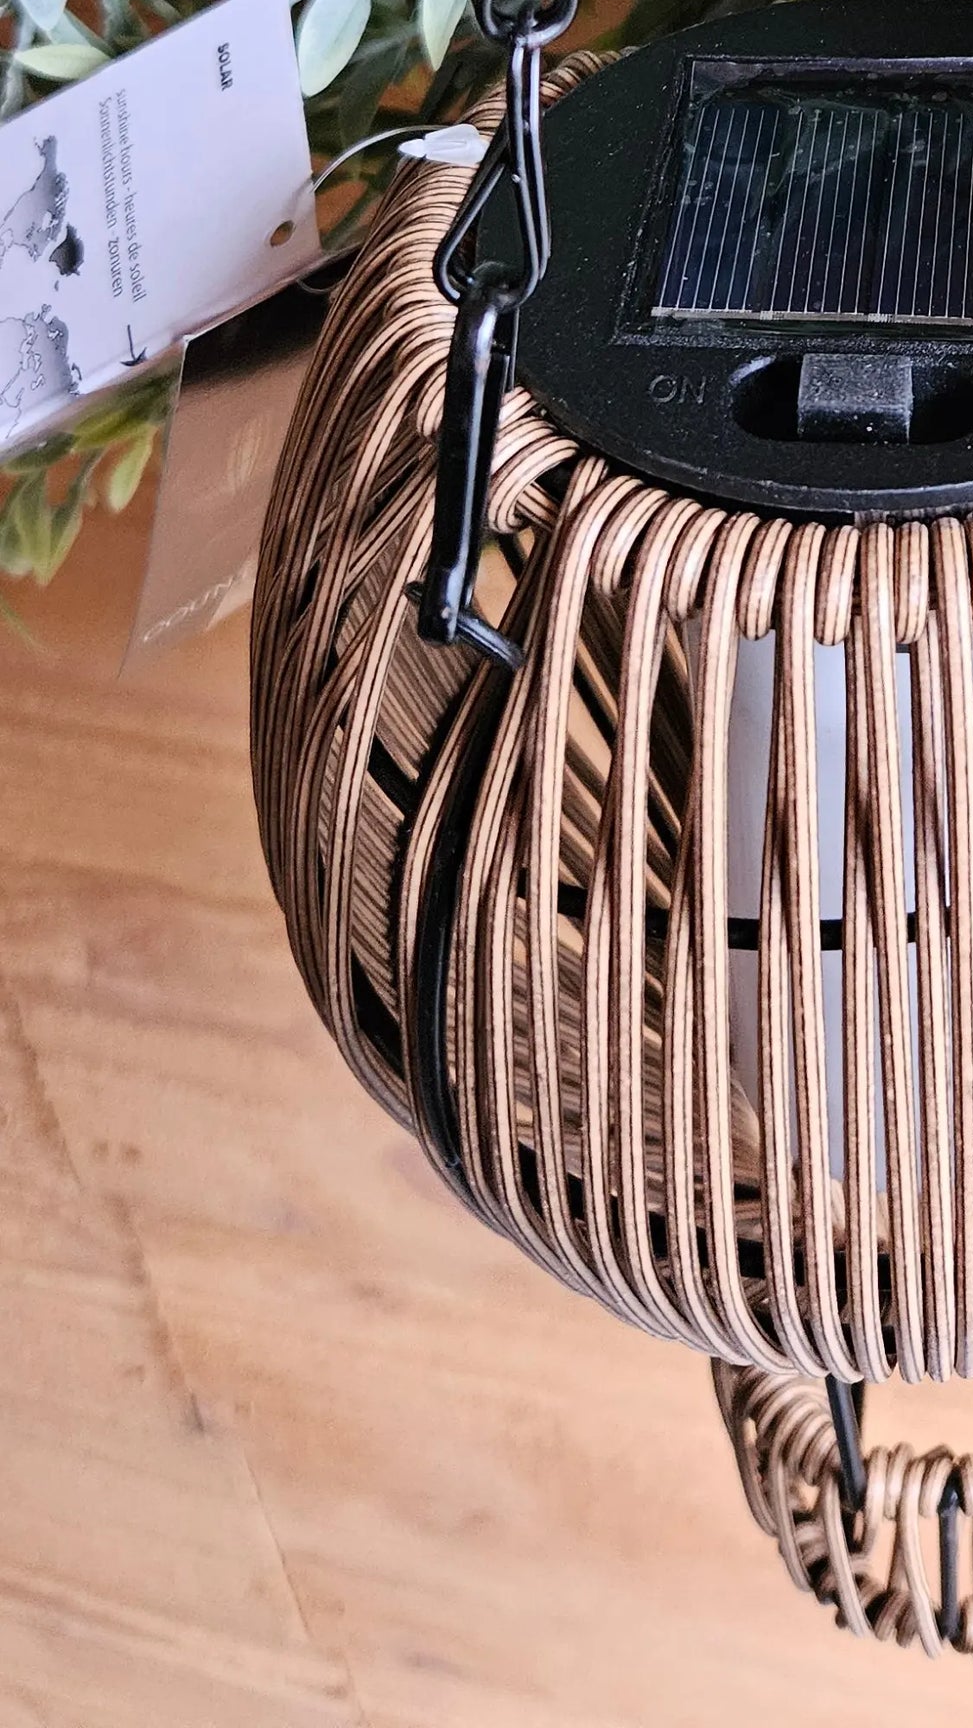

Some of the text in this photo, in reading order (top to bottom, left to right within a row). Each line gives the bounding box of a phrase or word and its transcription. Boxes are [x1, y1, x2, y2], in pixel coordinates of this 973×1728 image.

[217, 42, 233, 92] SOLAR
[116, 88, 131, 145] sunshine
[99, 96, 119, 230] Sonnenlichtstunden
[120, 144, 134, 186] hours
[124, 192, 137, 242] heures
[108, 236, 124, 298] zonuren
[127, 242, 142, 261] de
[129, 264, 148, 304] soleil
[648, 374, 707, 405] ON
